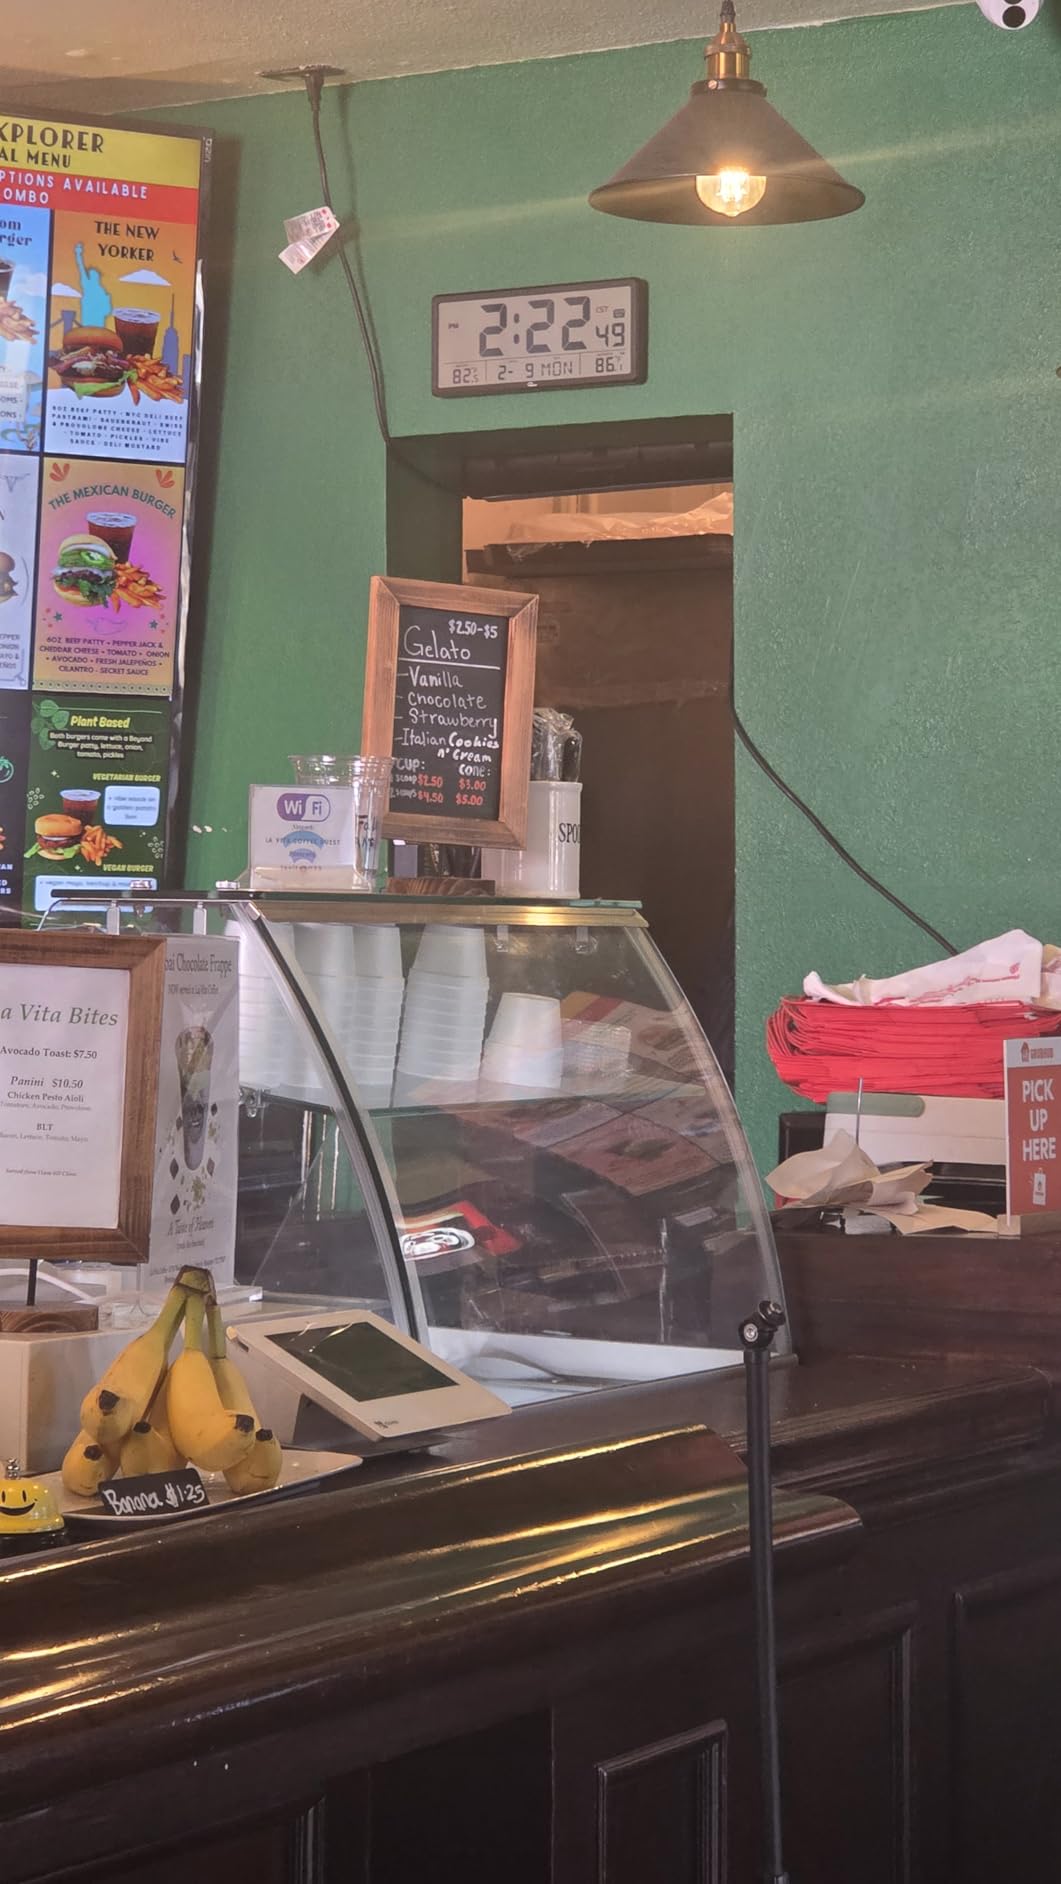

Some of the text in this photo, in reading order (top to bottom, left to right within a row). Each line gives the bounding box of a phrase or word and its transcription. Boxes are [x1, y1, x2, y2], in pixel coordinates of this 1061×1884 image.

[27, 150, 71, 169] MENU
[3, 187, 49, 205] OMBO
[63, 177, 148, 200] AVAILABLE
[94, 220, 160, 240] THE NEW
[98, 243, 155, 261] YORKER
[479, 296, 590, 357] 2:22
[595, 323, 625, 347] 49
[541, 361, 573, 377] MON
[48, 484, 176, 519] THE MEXICAN BURGER
[40, 645, 72, 653] CHEDDAR
[73, 646, 99, 654] CHEESE
[82, 638, 105, 646] PATTY
[404, 625, 471, 660] Gelato
[52, 655, 88, 663] AVOCADO
[58, 665, 94, 673] CILANTRO
[126, 668, 148, 676] SAUCE
[409, 665, 463, 688] Vanilla
[408, 692, 487, 709] Chocolate
[70, 715, 131, 729] Plant Based
[409, 707, 497, 739] Strawberry
[401, 727, 499, 749] Italian Cookies
[452, 748, 492, 762] Cream
[92, 772, 161, 782] VEGETARIAN BURGER
[103, 863, 154, 873] VEGAN BURGER
[177, 953, 209, 972] Chocolate
[210, 953, 232, 977] Frappe
[20, 1003, 61, 1023] Vita
[68, 1007, 119, 1026] Bites
[0, 1046, 97, 1059] Avocado Toast: $7.50
[10, 1075, 84, 1089] Panini $10.50
[1022, 1078, 1055, 1103] PICK
[7, 1091, 84, 1103] Chicken Pesto Aioli
[36, 1123, 54, 1131] BLT
[1029, 1108, 1048, 1132] UP
[1022, 1137, 1057, 1162] HERE
[102, 1482, 205, 1515] Banana $1.25
